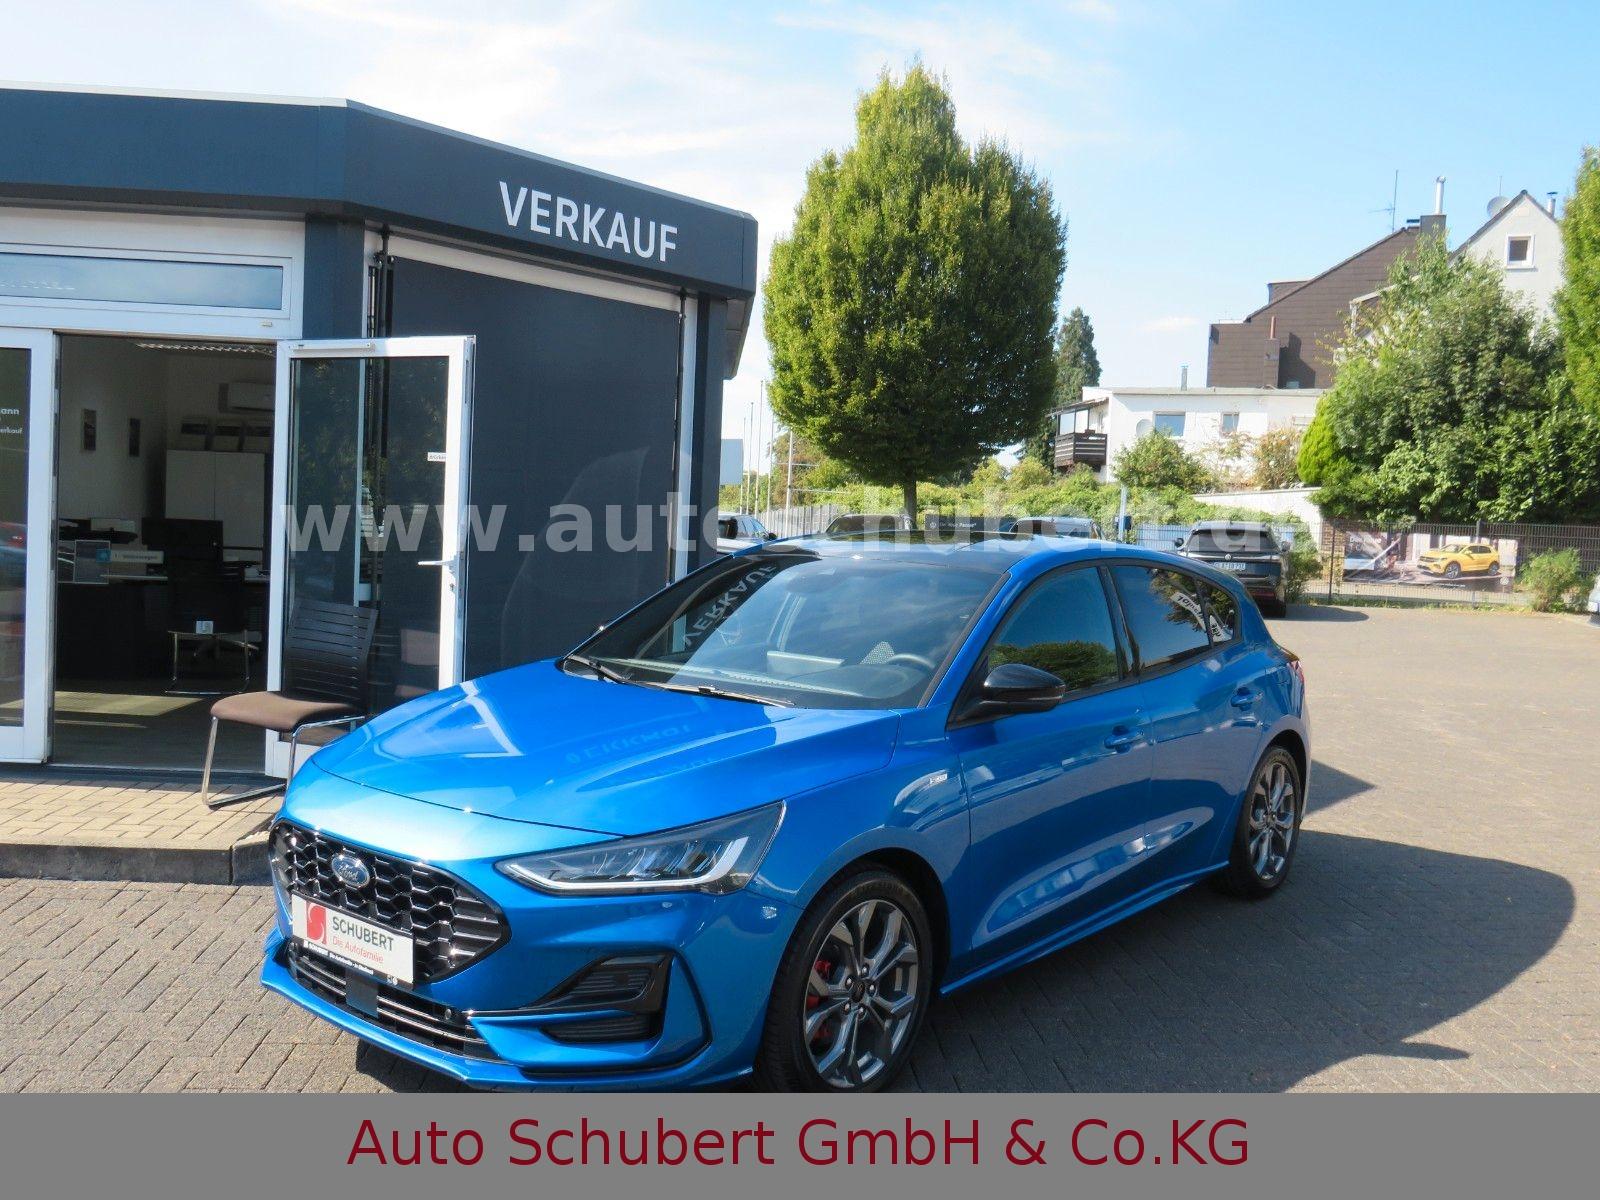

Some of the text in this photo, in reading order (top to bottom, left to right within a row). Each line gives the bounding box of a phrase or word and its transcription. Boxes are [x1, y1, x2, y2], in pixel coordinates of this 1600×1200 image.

[499, 181, 679, 263] VERKAUF
[332, 916, 395, 951] SCHUBERT
[333, 935, 384, 964] Die Autofamilie
